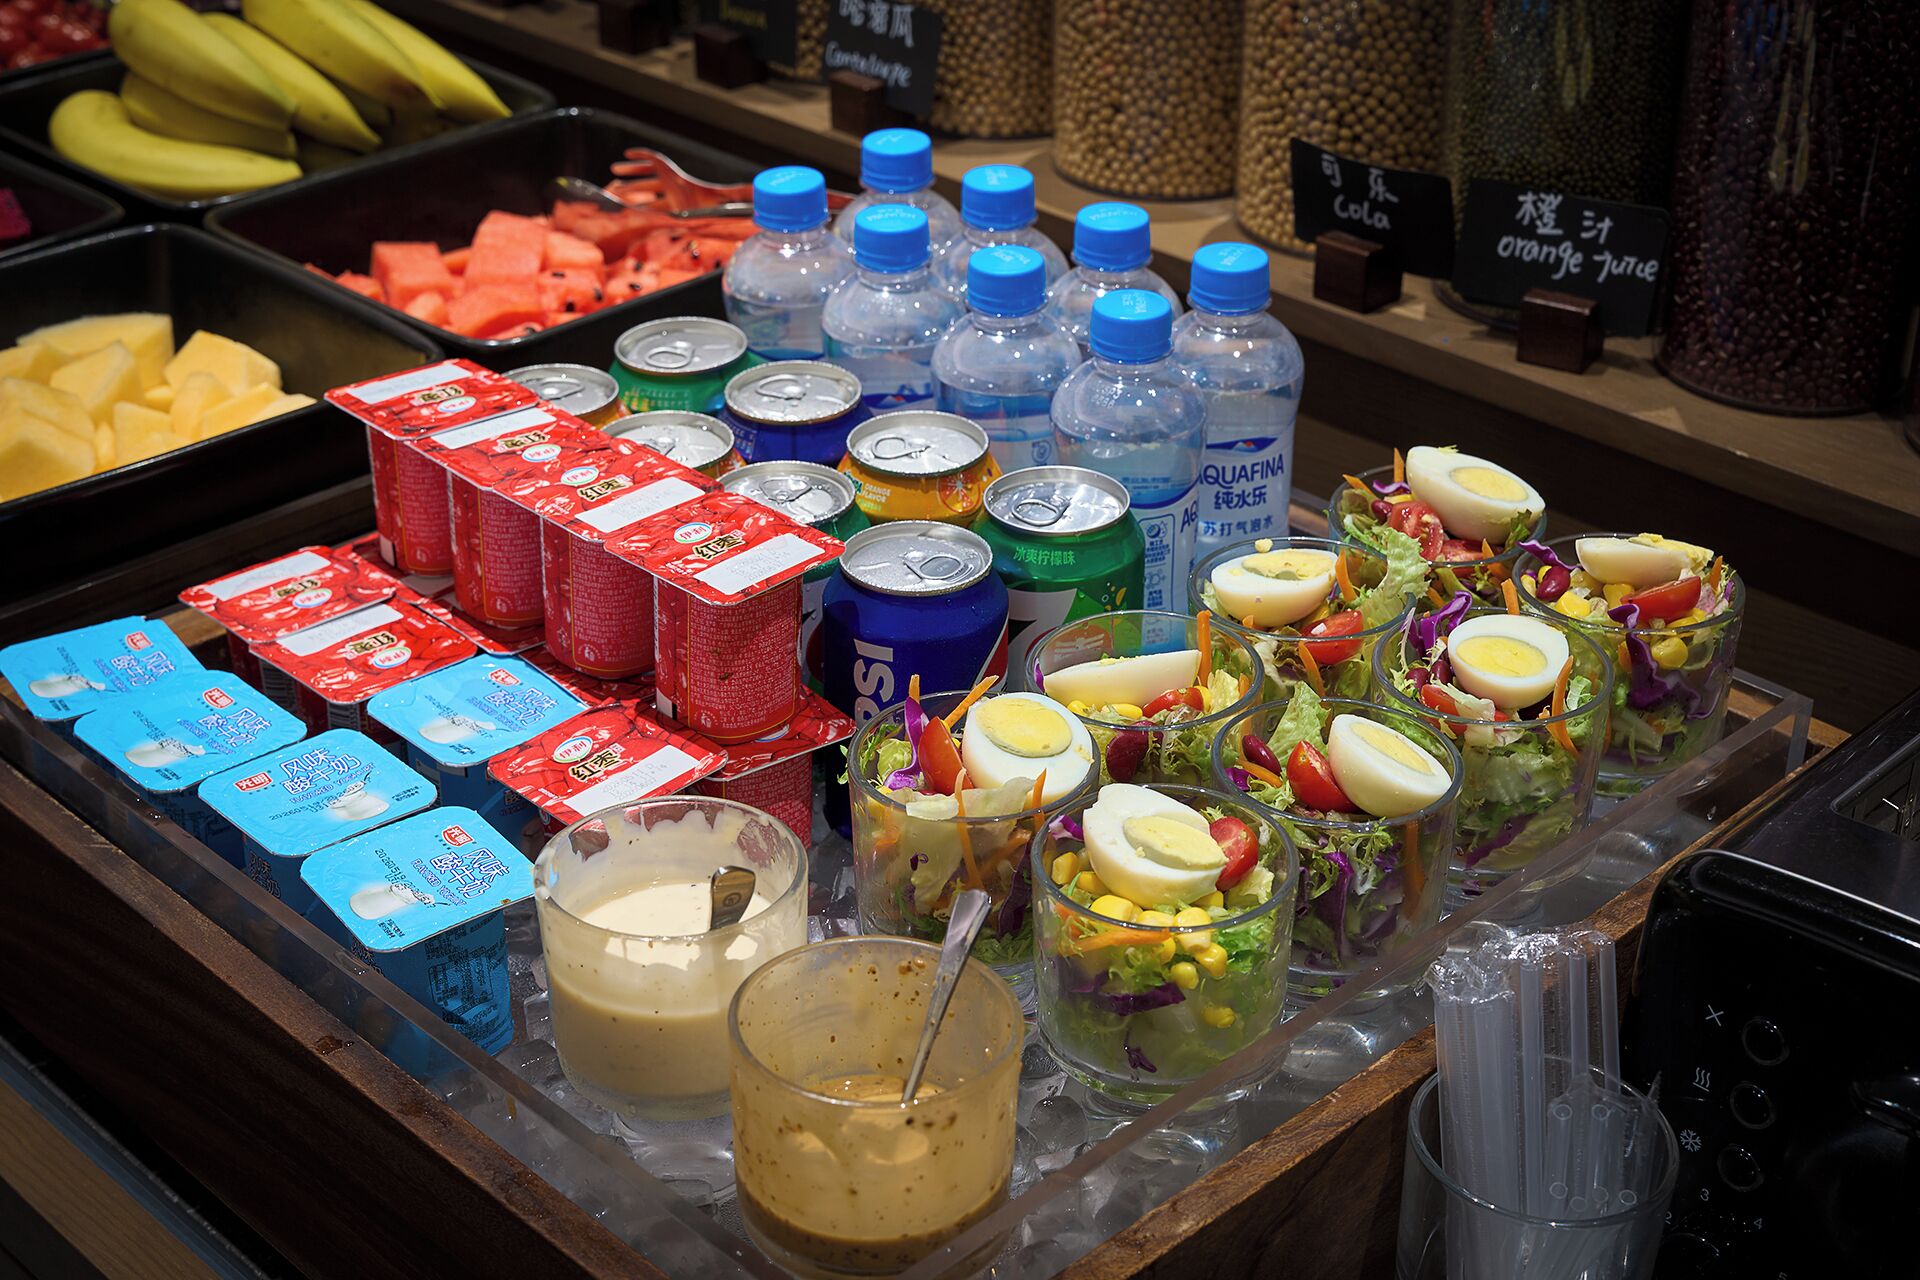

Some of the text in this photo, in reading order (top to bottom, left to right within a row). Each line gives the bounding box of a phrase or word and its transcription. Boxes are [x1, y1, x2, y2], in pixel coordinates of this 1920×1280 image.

[1321, 153, 1399, 203] 可乐
[1334, 194, 1391, 230] Cola
[1515, 190, 1614, 244] 橙汁
[1497, 235, 1583, 280] orange
[580, 478, 627, 501] 红枣
[1214, 484, 1267, 510] 纯水乐
[679, 526, 707, 540] 伊利
[695, 534, 743, 560] 红枣
[1013, 546, 1076, 566] 冰爽柠檬味
[853, 638, 895, 733] PSI
[226, 707, 271, 735] 风味
[280, 747, 336, 778] 风味
[559, 740, 587, 759] 伊利
[280, 753, 361, 795] 酸牛奶
[571, 749, 620, 781] 红枣
[238, 773, 270, 790] 光明
[430, 851, 491, 899] 酸牛奶
[461, 848, 510, 883] 风味
[1700, 1188, 1709, 1201] 3
[1753, 1218, 1762, 1230] 4
